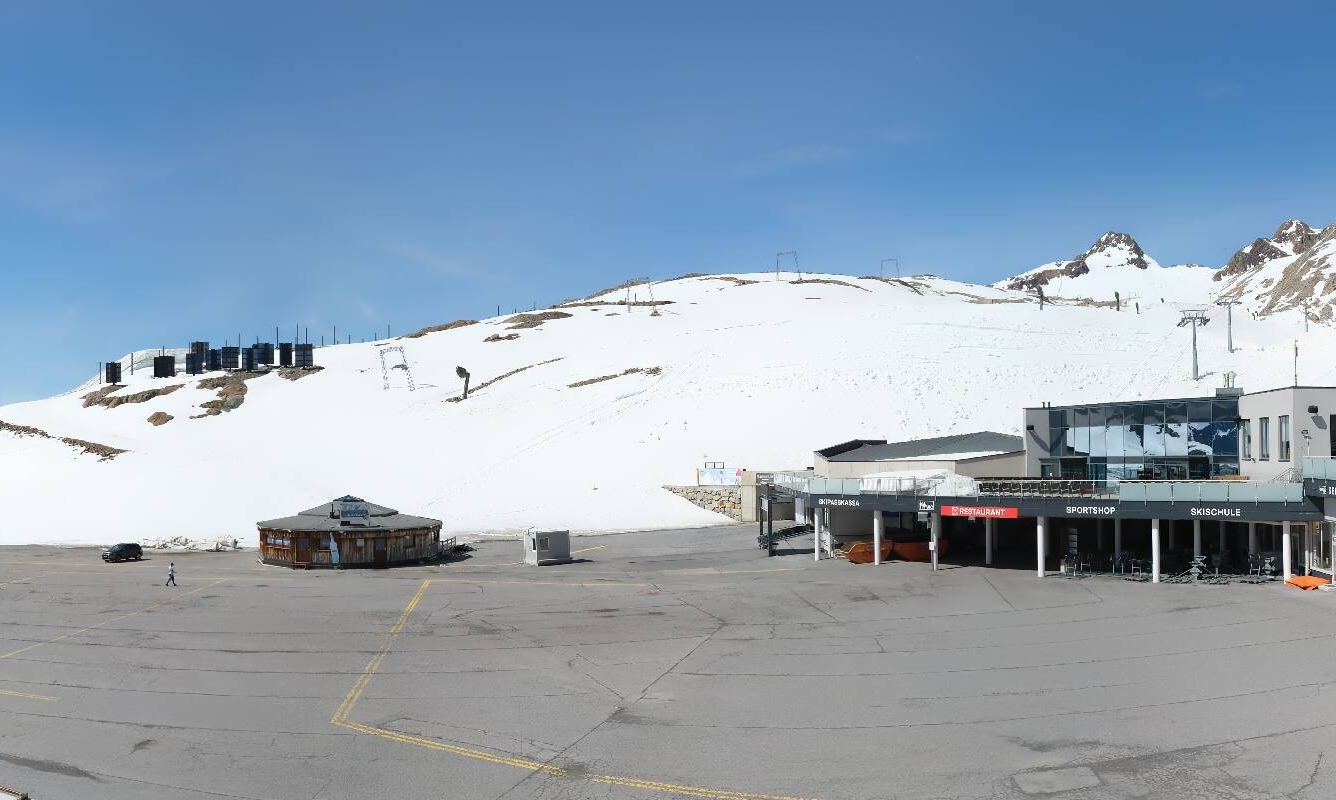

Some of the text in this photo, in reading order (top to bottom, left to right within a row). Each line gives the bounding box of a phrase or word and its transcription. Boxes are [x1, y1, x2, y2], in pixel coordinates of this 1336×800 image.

[818, 498, 860, 507] SKIPASSKASSA
[959, 507, 1006, 517] RESTAURANT
[1066, 506, 1116, 515] SPORTSHOP
[1190, 507, 1241, 517] SKISCHULE
